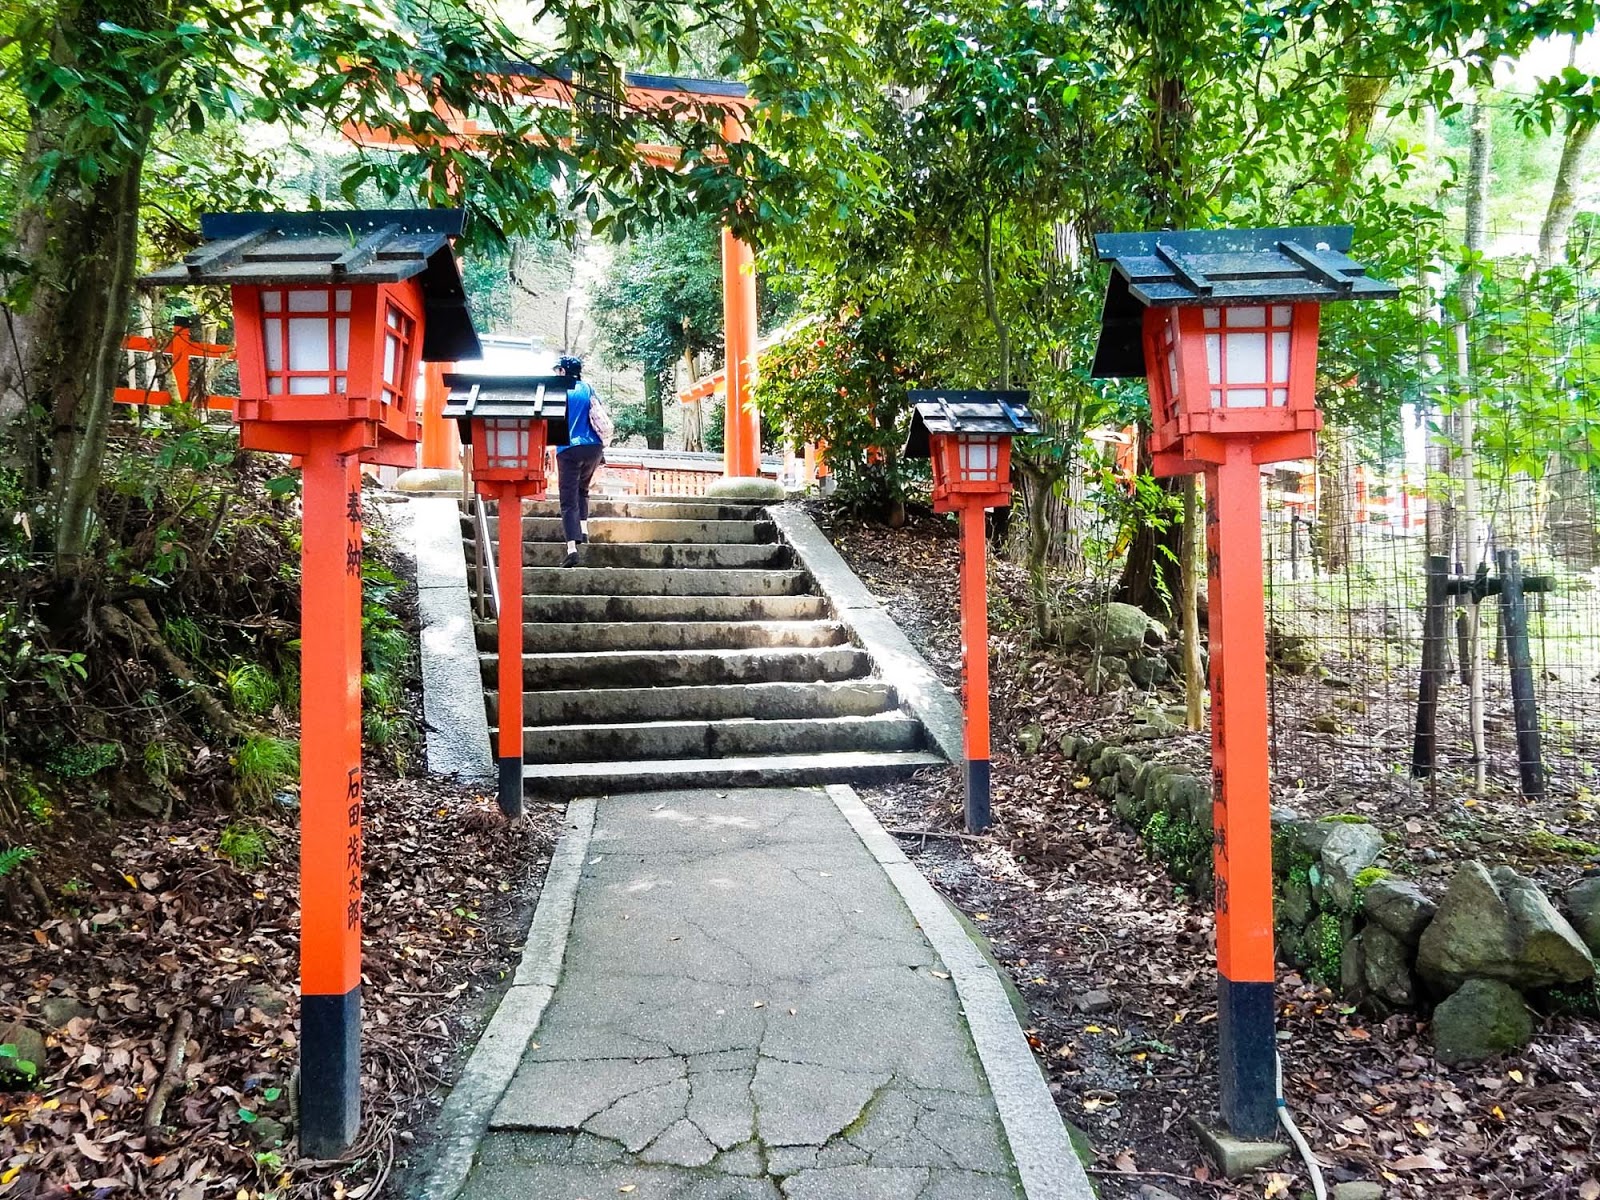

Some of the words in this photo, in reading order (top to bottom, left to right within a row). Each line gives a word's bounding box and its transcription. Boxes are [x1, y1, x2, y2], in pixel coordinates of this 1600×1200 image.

[346, 484, 361, 579] 奉納
[346, 767, 360, 932] 石田茂太郎
